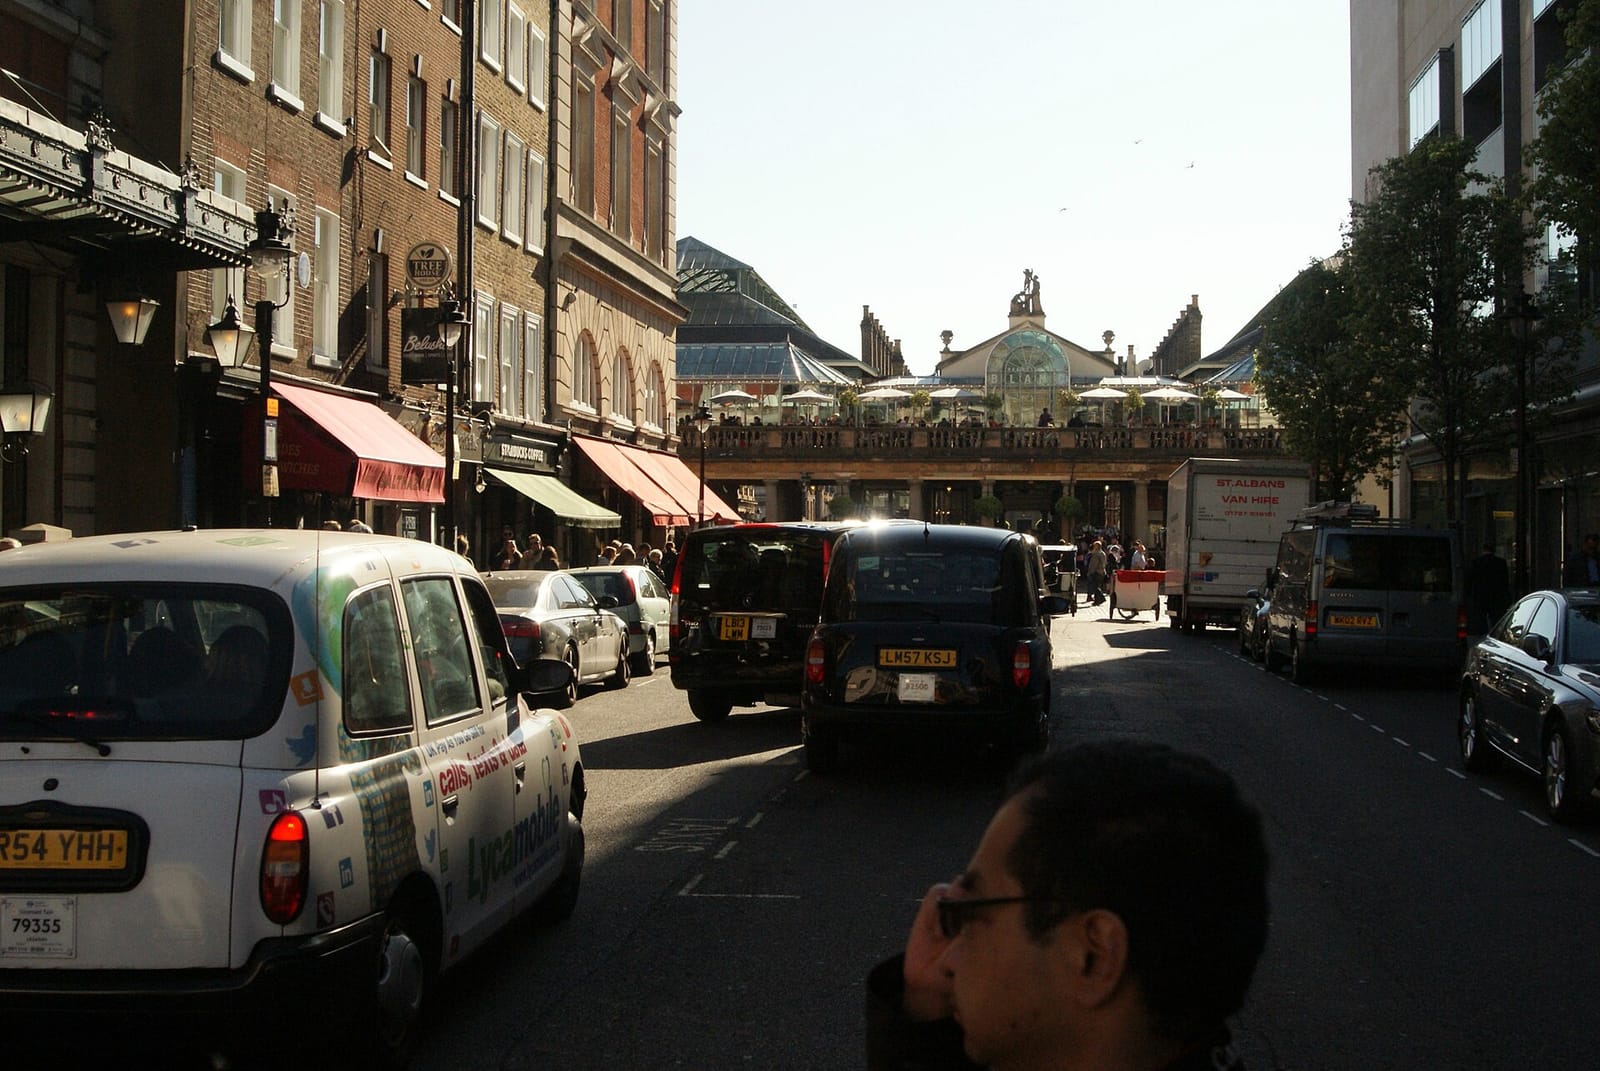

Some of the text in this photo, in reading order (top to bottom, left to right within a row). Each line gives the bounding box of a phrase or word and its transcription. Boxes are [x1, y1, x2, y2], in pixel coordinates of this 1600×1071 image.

[413, 261, 442, 270] TREE
[501, 443, 528, 459] STARBUCKS
[528, 447, 544, 462] COFFEE
[1221, 495, 1280, 505] VAN HIRE
[885, 651, 951, 664] LM57 KSJ
[438, 762, 473, 796] calls,
[59, 832, 114, 861] YHH
[467, 785, 560, 905] Lycamobile
[12, 918, 61, 933] 79355
